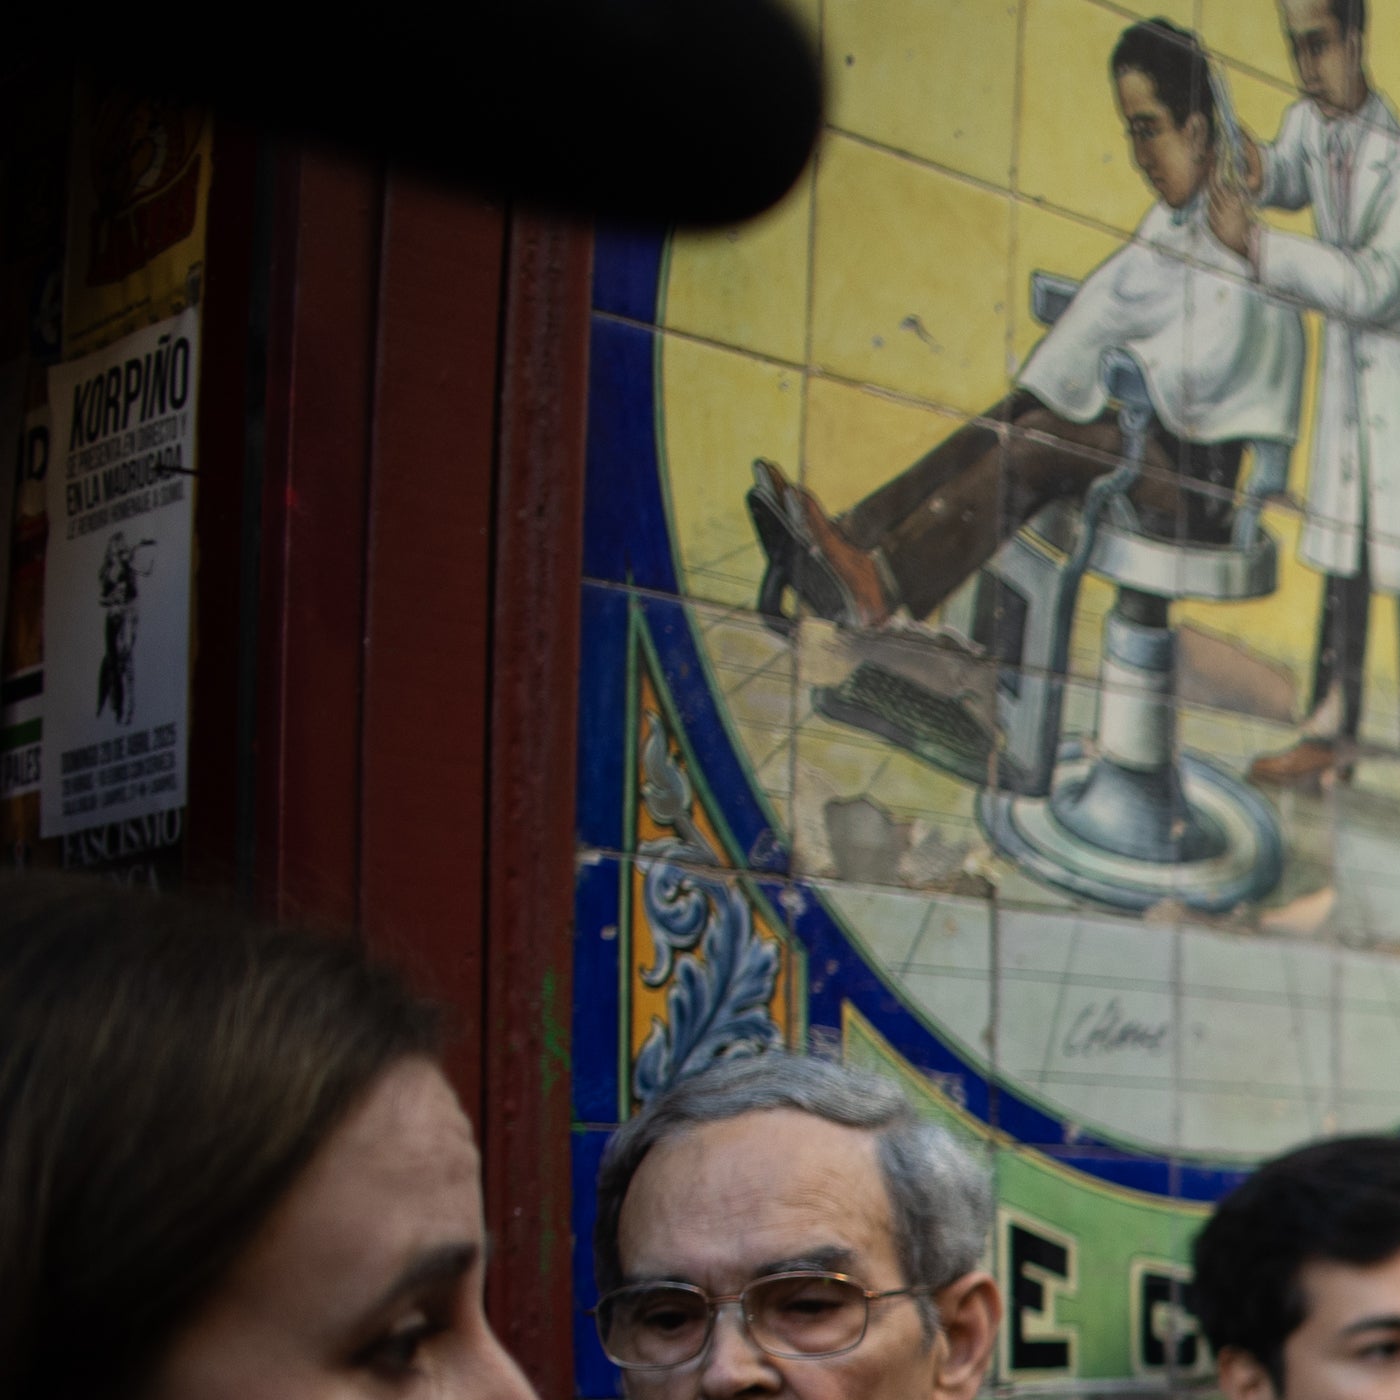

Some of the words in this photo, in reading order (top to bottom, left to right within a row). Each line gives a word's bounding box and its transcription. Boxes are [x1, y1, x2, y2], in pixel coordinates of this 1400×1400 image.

[69, 334, 190, 451] KORPIÑO
[67, 481, 83, 516] EN
[84, 474, 100, 509] LA
[103, 444, 182, 501] MADRUGADA
[1006, 1219, 1071, 1372] E
